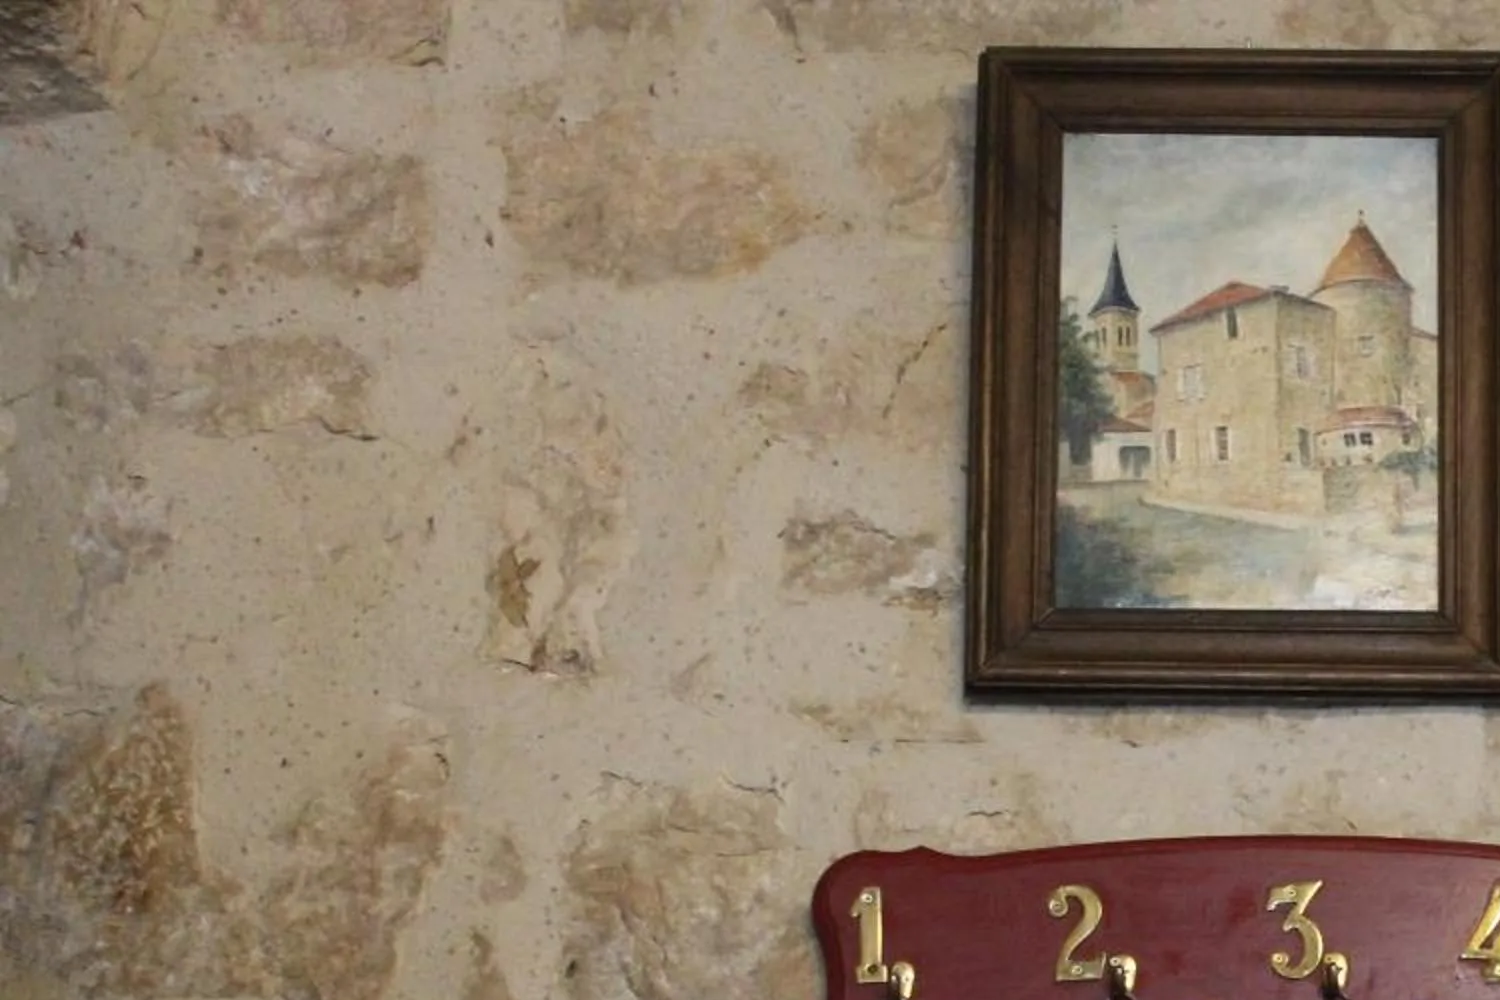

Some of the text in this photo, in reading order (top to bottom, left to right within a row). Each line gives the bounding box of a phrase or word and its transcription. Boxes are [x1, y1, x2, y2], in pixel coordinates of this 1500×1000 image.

[849, 886, 889, 984] 1
[1048, 884, 1107, 982] 2
[1267, 880, 1324, 980] 3
